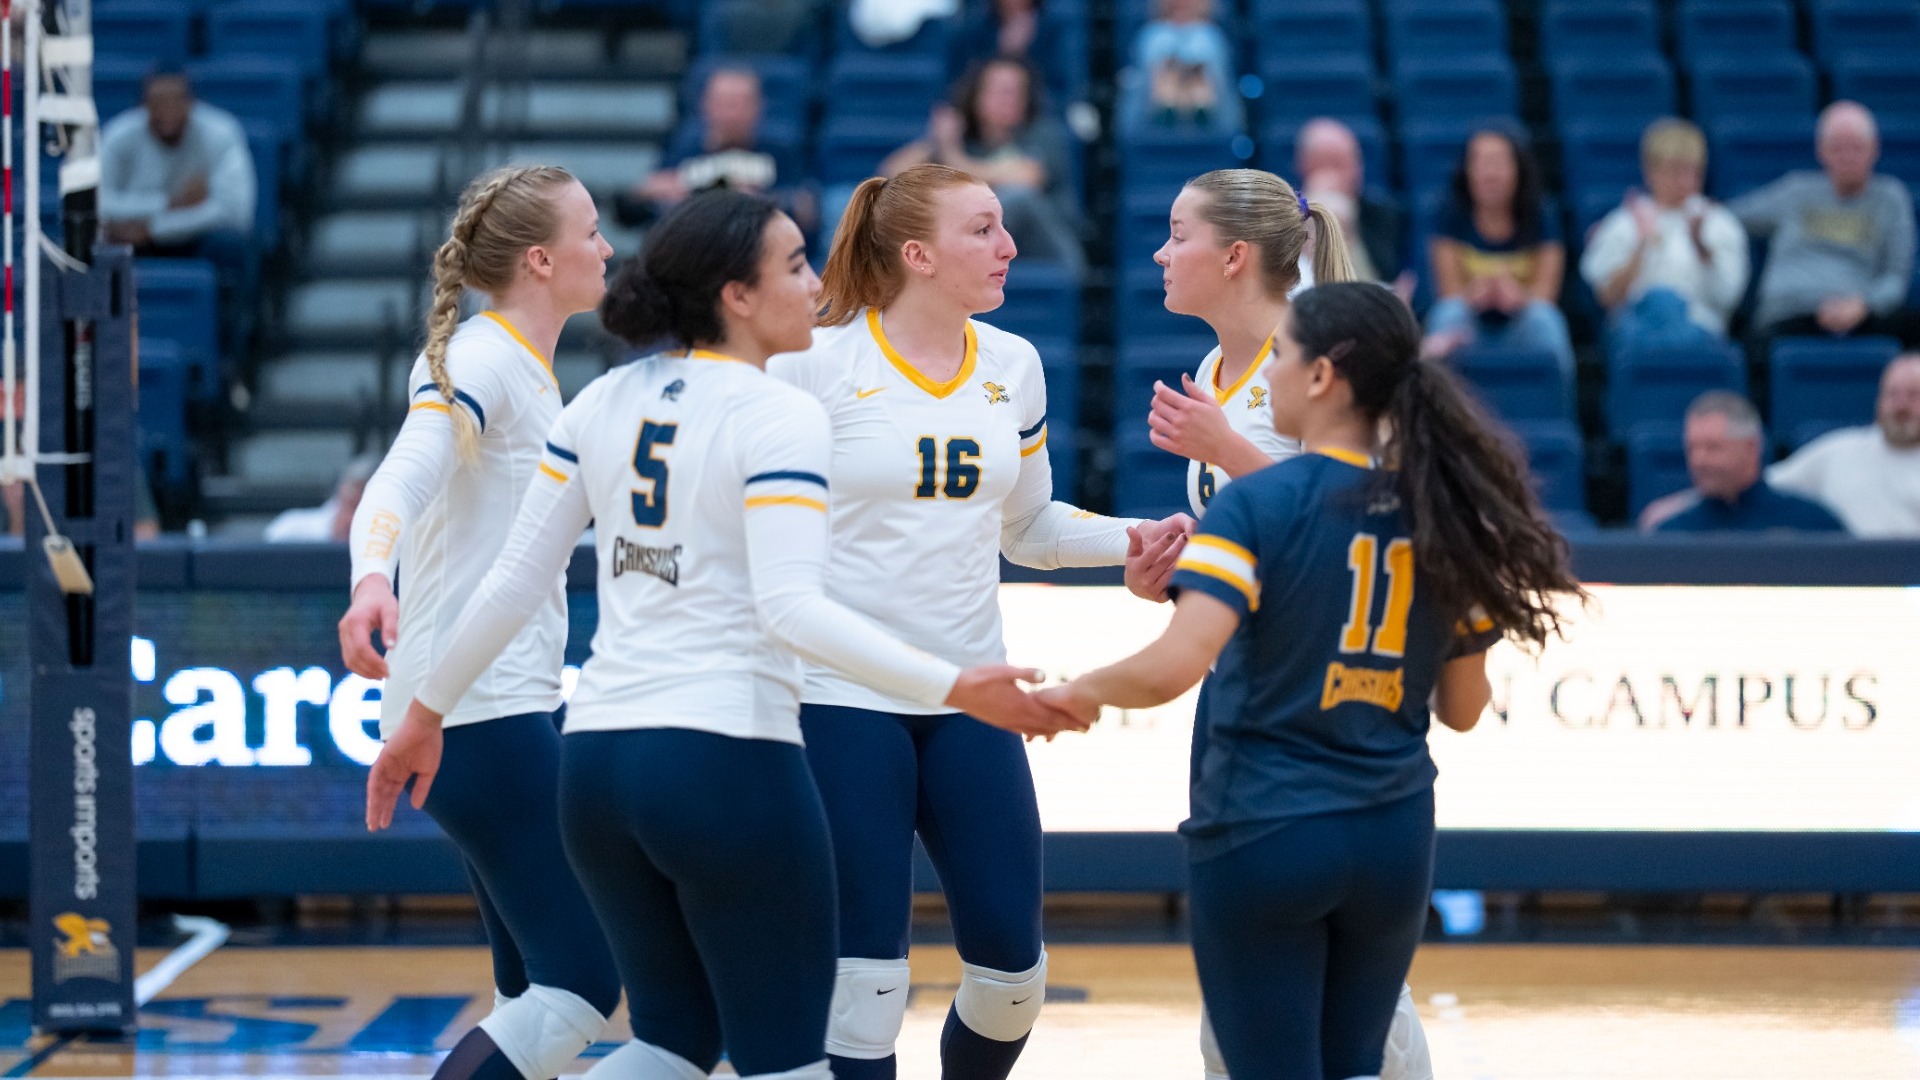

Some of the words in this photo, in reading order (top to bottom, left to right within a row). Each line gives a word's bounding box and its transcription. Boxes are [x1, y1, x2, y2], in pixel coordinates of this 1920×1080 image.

[631, 418, 679, 529] 5
[914, 434, 983, 501] 16
[1338, 532, 1415, 659] 11
[1549, 671, 1880, 731] CAMPUS
